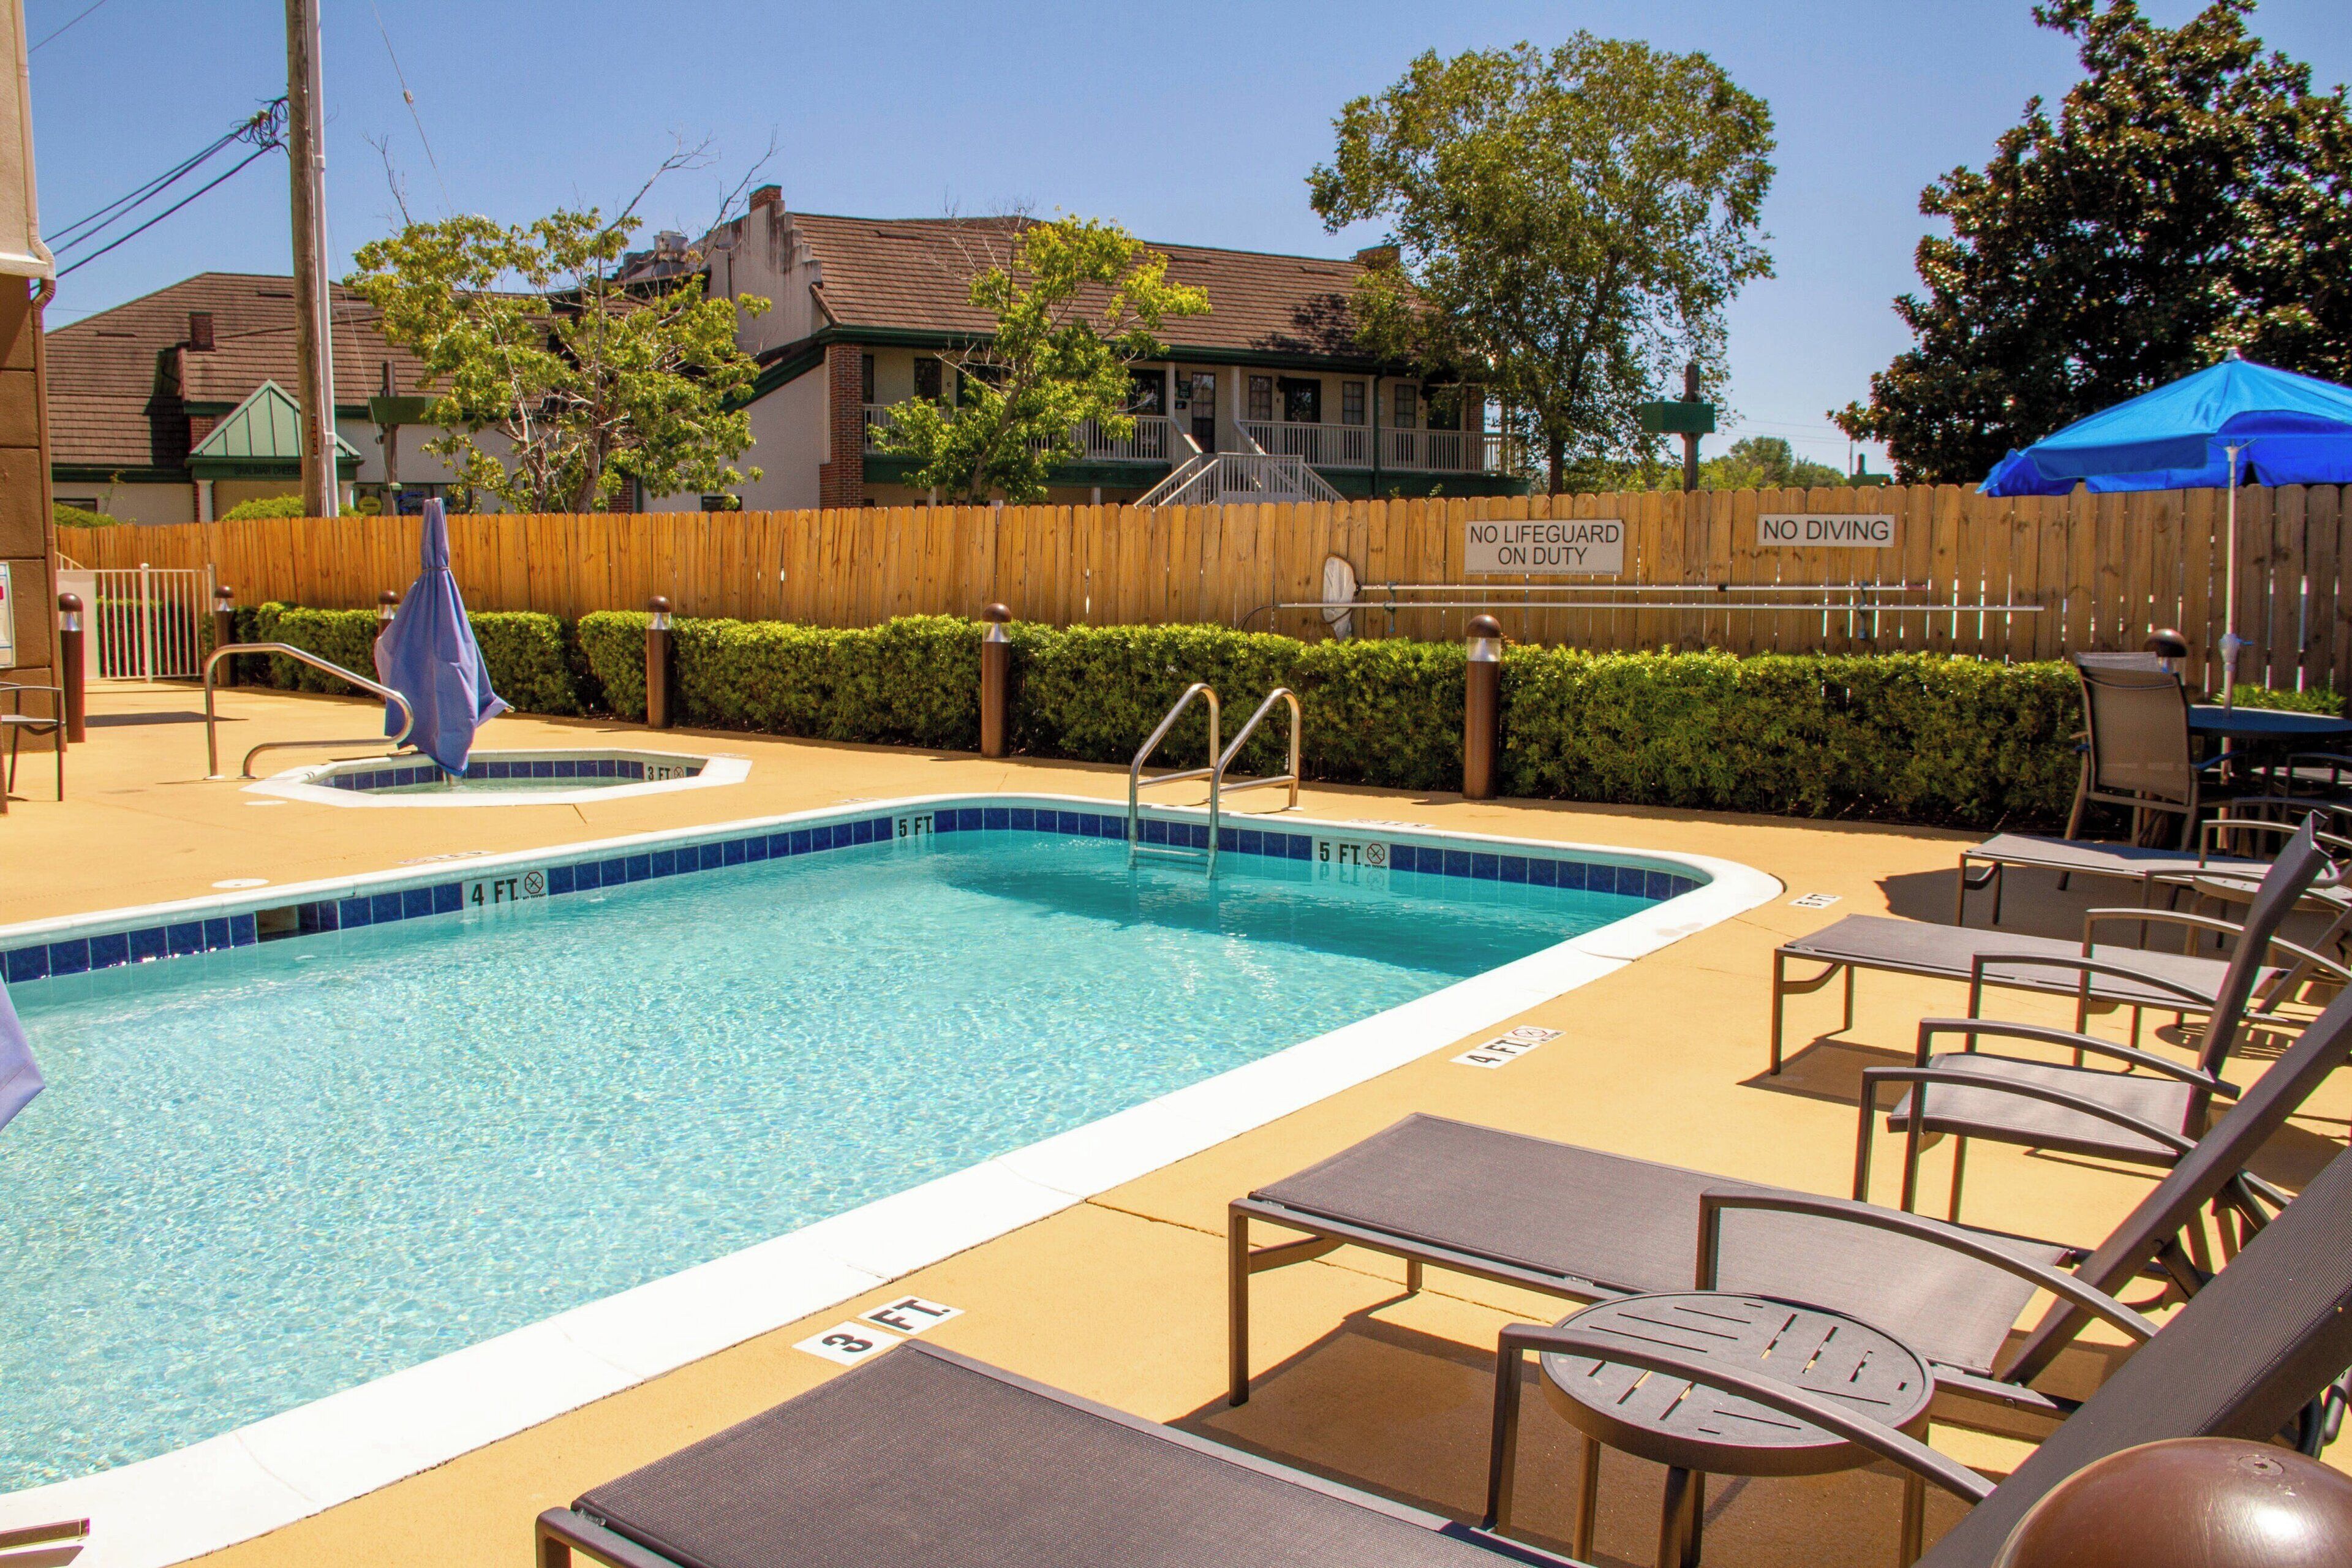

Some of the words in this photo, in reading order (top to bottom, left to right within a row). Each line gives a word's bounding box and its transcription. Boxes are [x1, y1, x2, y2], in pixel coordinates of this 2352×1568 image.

[1470, 525, 1498, 543] NO
[1504, 524, 1619, 543] LIFEGUARD
[1763, 520, 1798, 540] NO
[1806, 521, 1889, 540] DIVING
[1498, 547, 1526, 565] ON
[1533, 546, 1588, 565] DUTY
[648, 767, 654, 780] 3
[899, 819, 907, 837] 5
[1319, 842, 1330, 862] 5
[472, 883, 484, 906] 4
[1466, 1054, 1502, 1063] 4
[821, 1333, 873, 1353] 3
[868, 1298, 951, 1331] FT.
